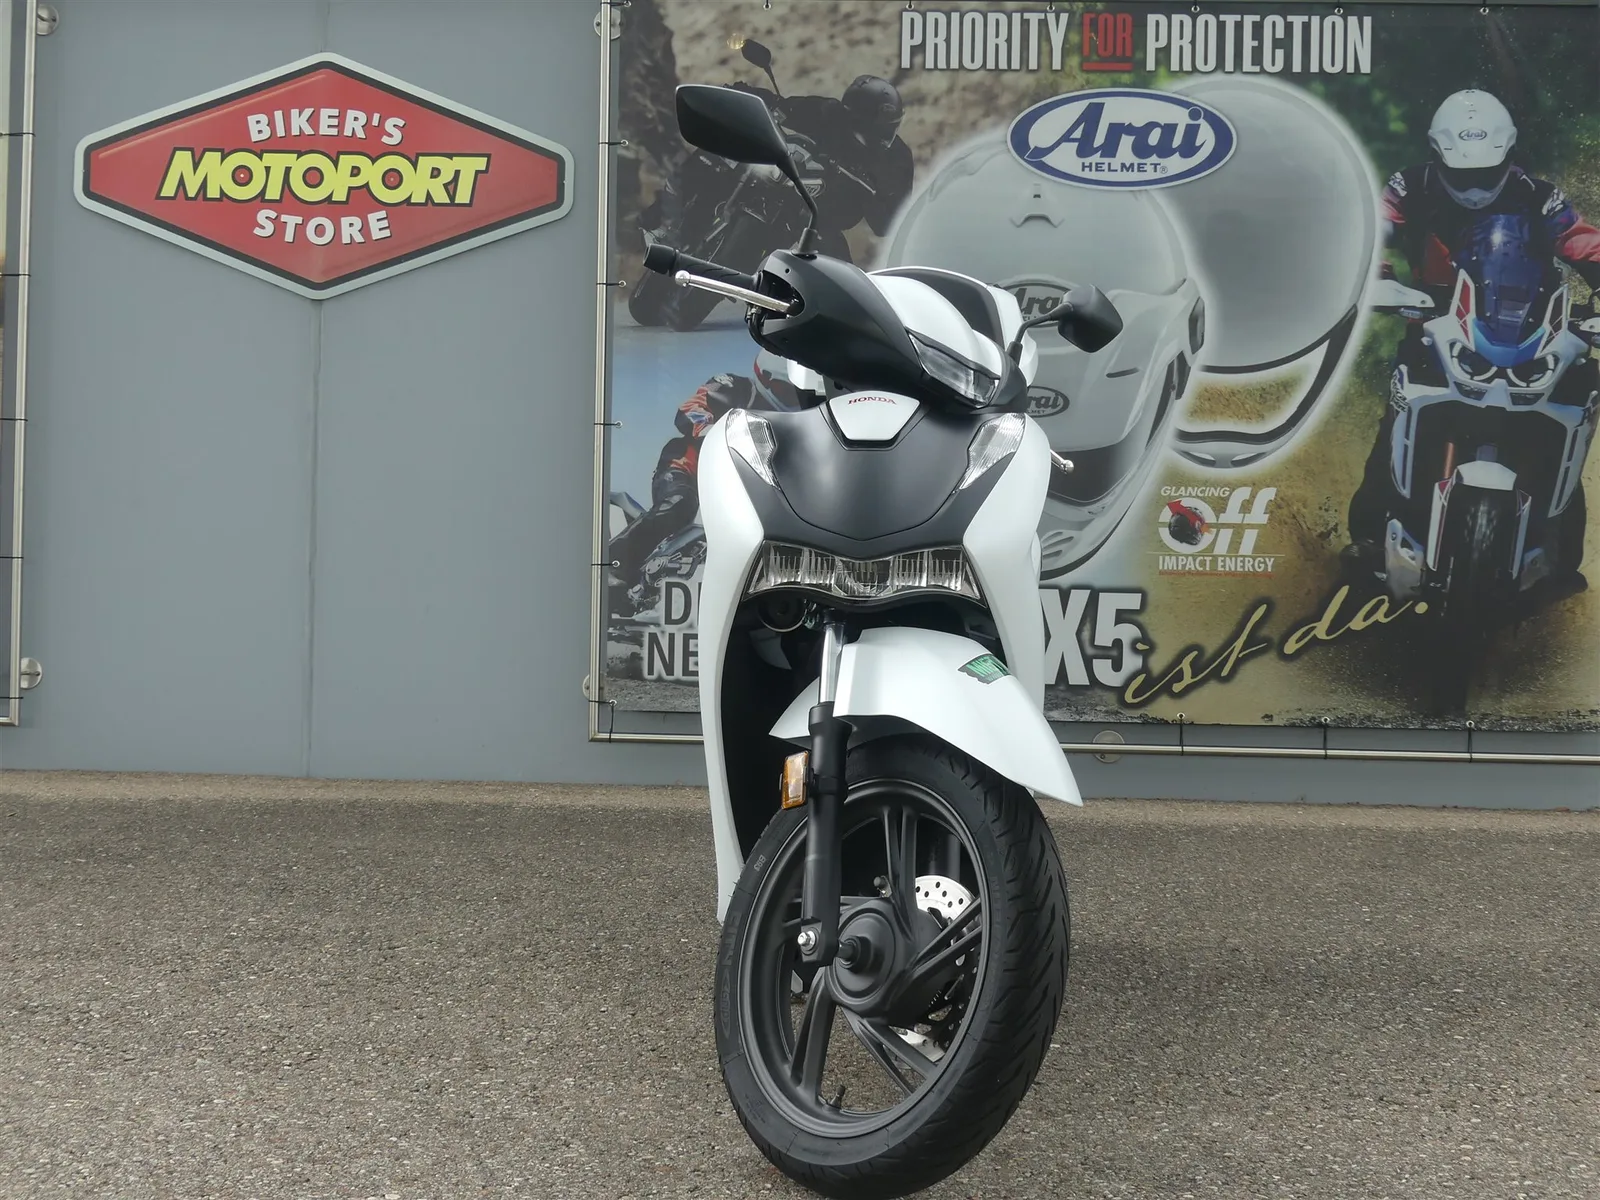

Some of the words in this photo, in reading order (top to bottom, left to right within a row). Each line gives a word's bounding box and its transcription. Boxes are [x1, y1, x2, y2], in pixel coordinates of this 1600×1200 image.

[901, 11, 1069, 70] PRIORITY
[1082, 12, 1133, 57] FOR
[1146, 13, 1372, 74] PROTECTION
[247, 107, 406, 146] BIKER'S
[1025, 101, 1206, 161] Arai
[157, 148, 491, 206] MOTOPORT
[252, 209, 393, 246] STORE
[848, 397, 897, 405] HONDA
[1161, 486, 1230, 497] GLANCING
[1158, 555, 1212, 572] IMPACT
[1217, 556, 1275, 573] ENERGY
